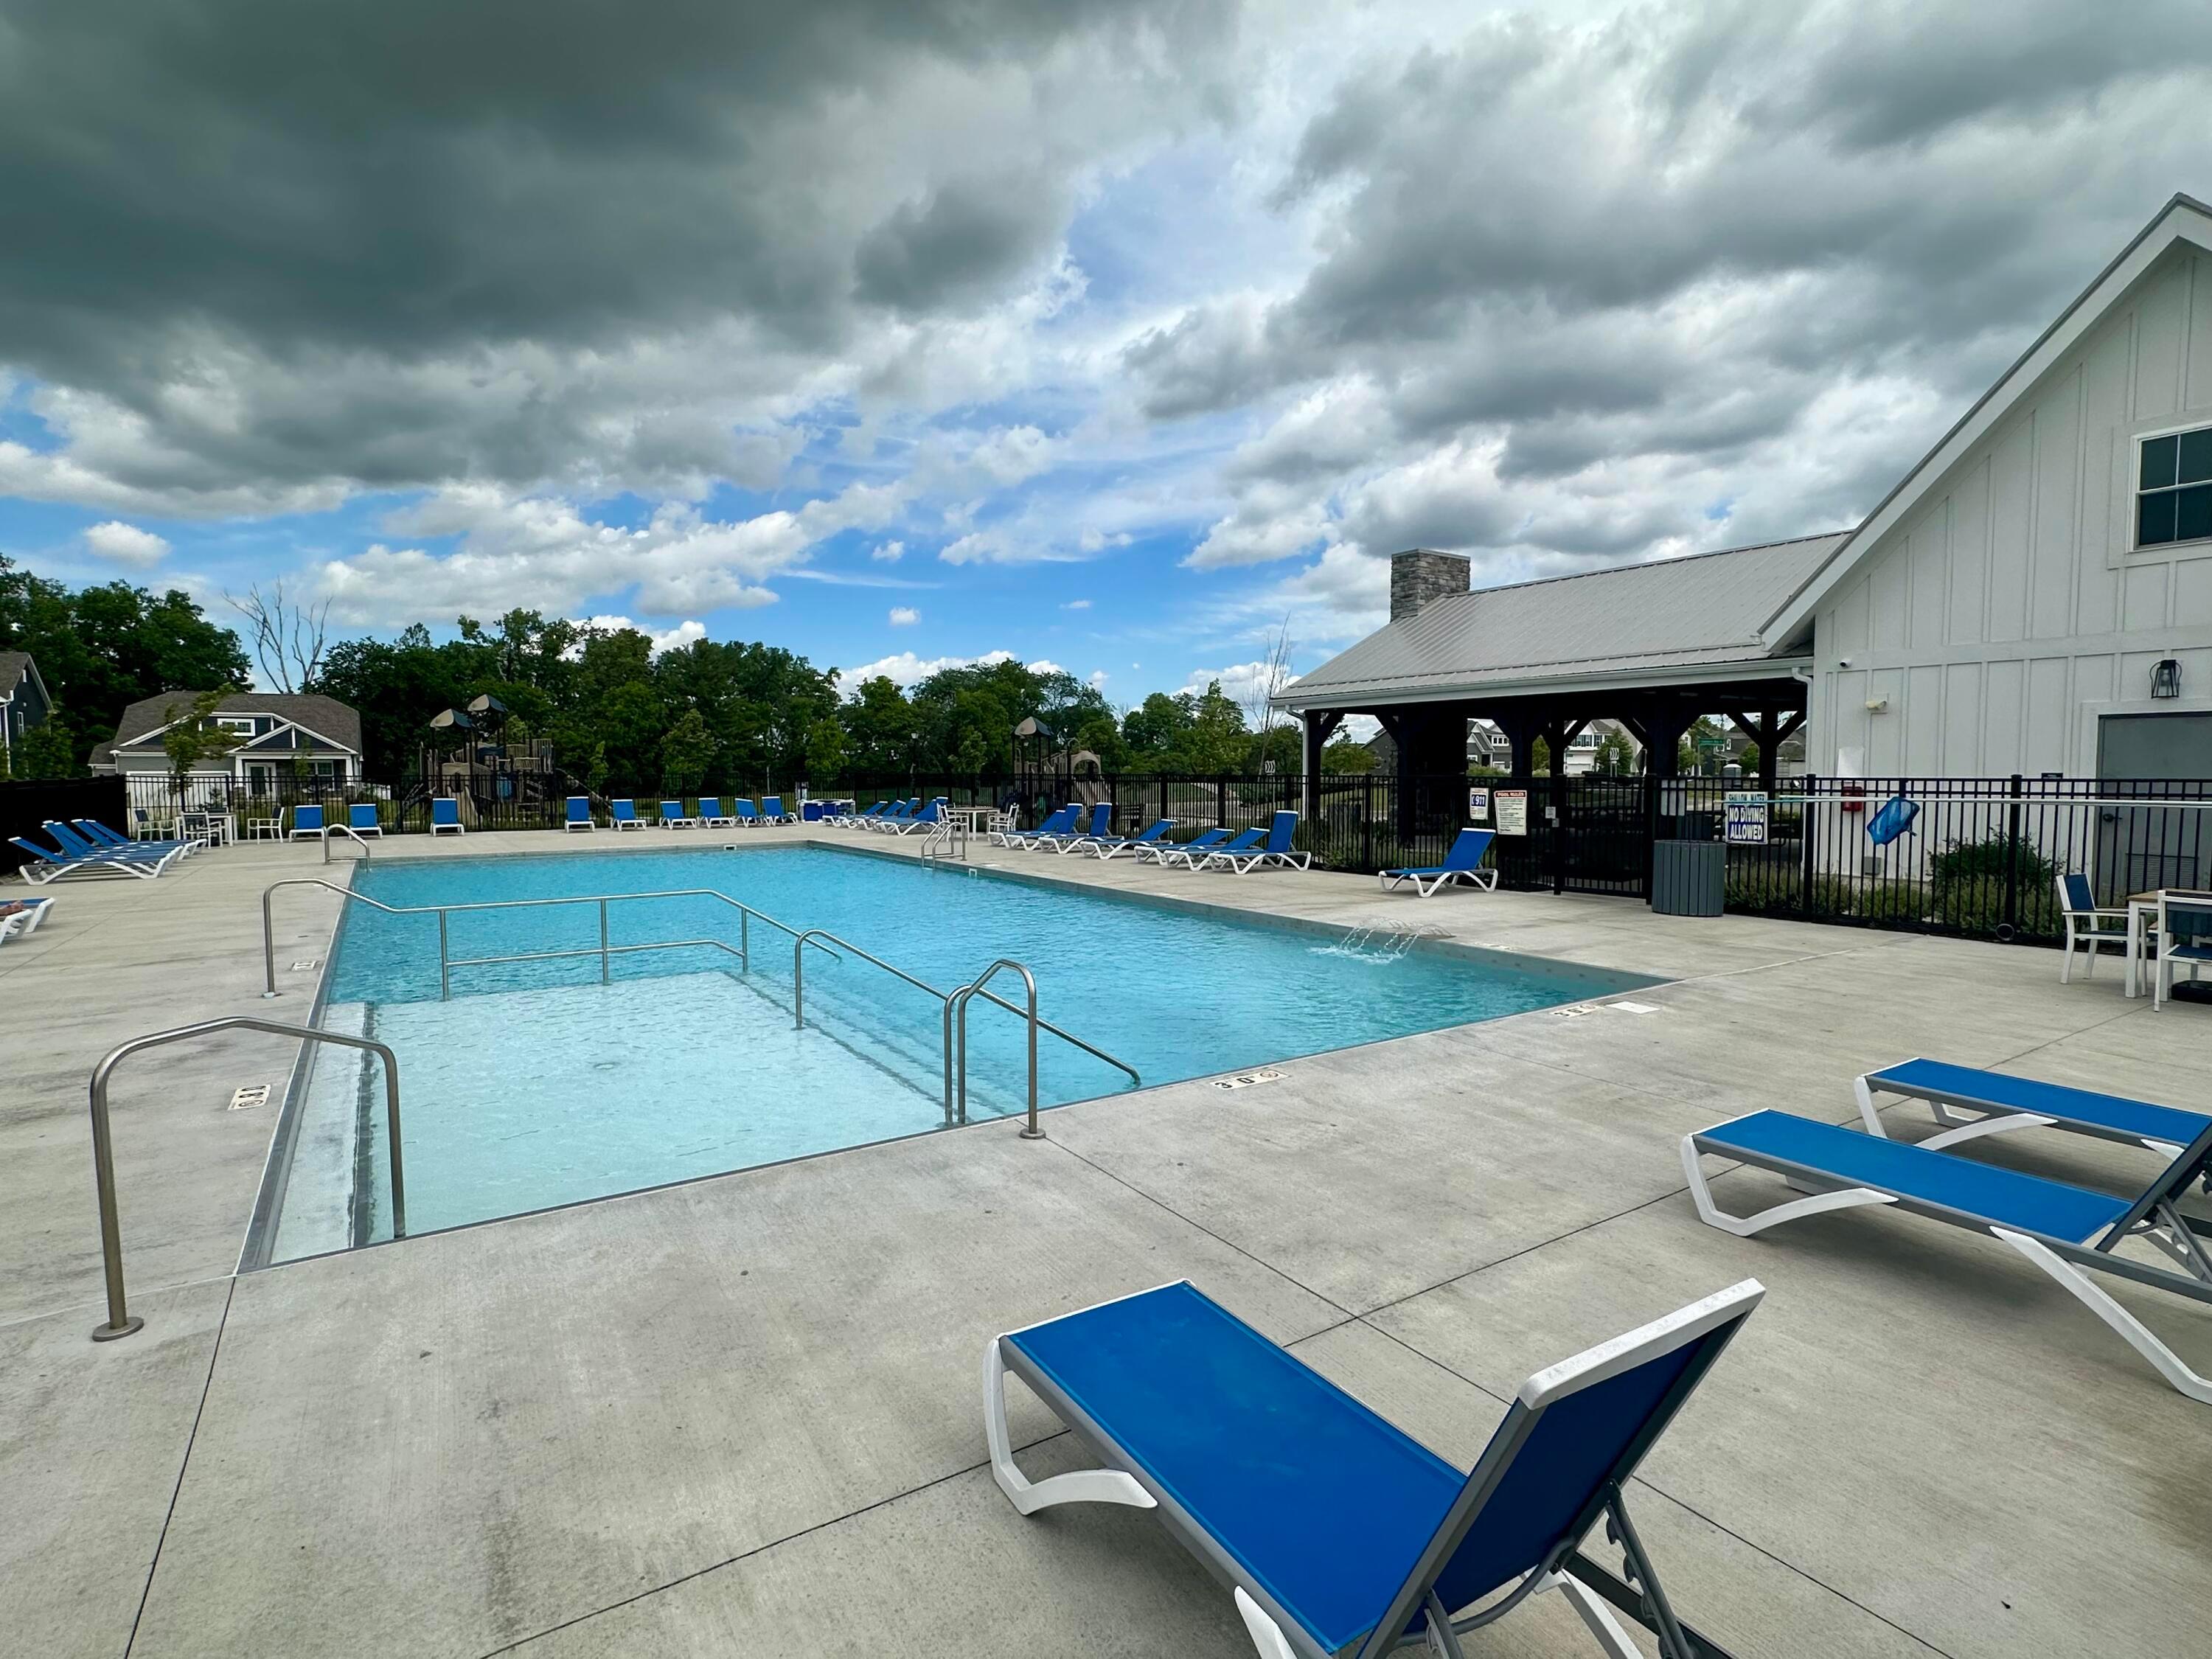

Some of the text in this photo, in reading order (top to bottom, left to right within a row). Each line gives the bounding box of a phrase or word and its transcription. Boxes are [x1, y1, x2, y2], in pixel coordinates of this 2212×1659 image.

[1475, 795, 1485, 805] 911
[1729, 807, 1764, 823] NO DIVING
[1730, 824, 1763, 840] ALLOWED
